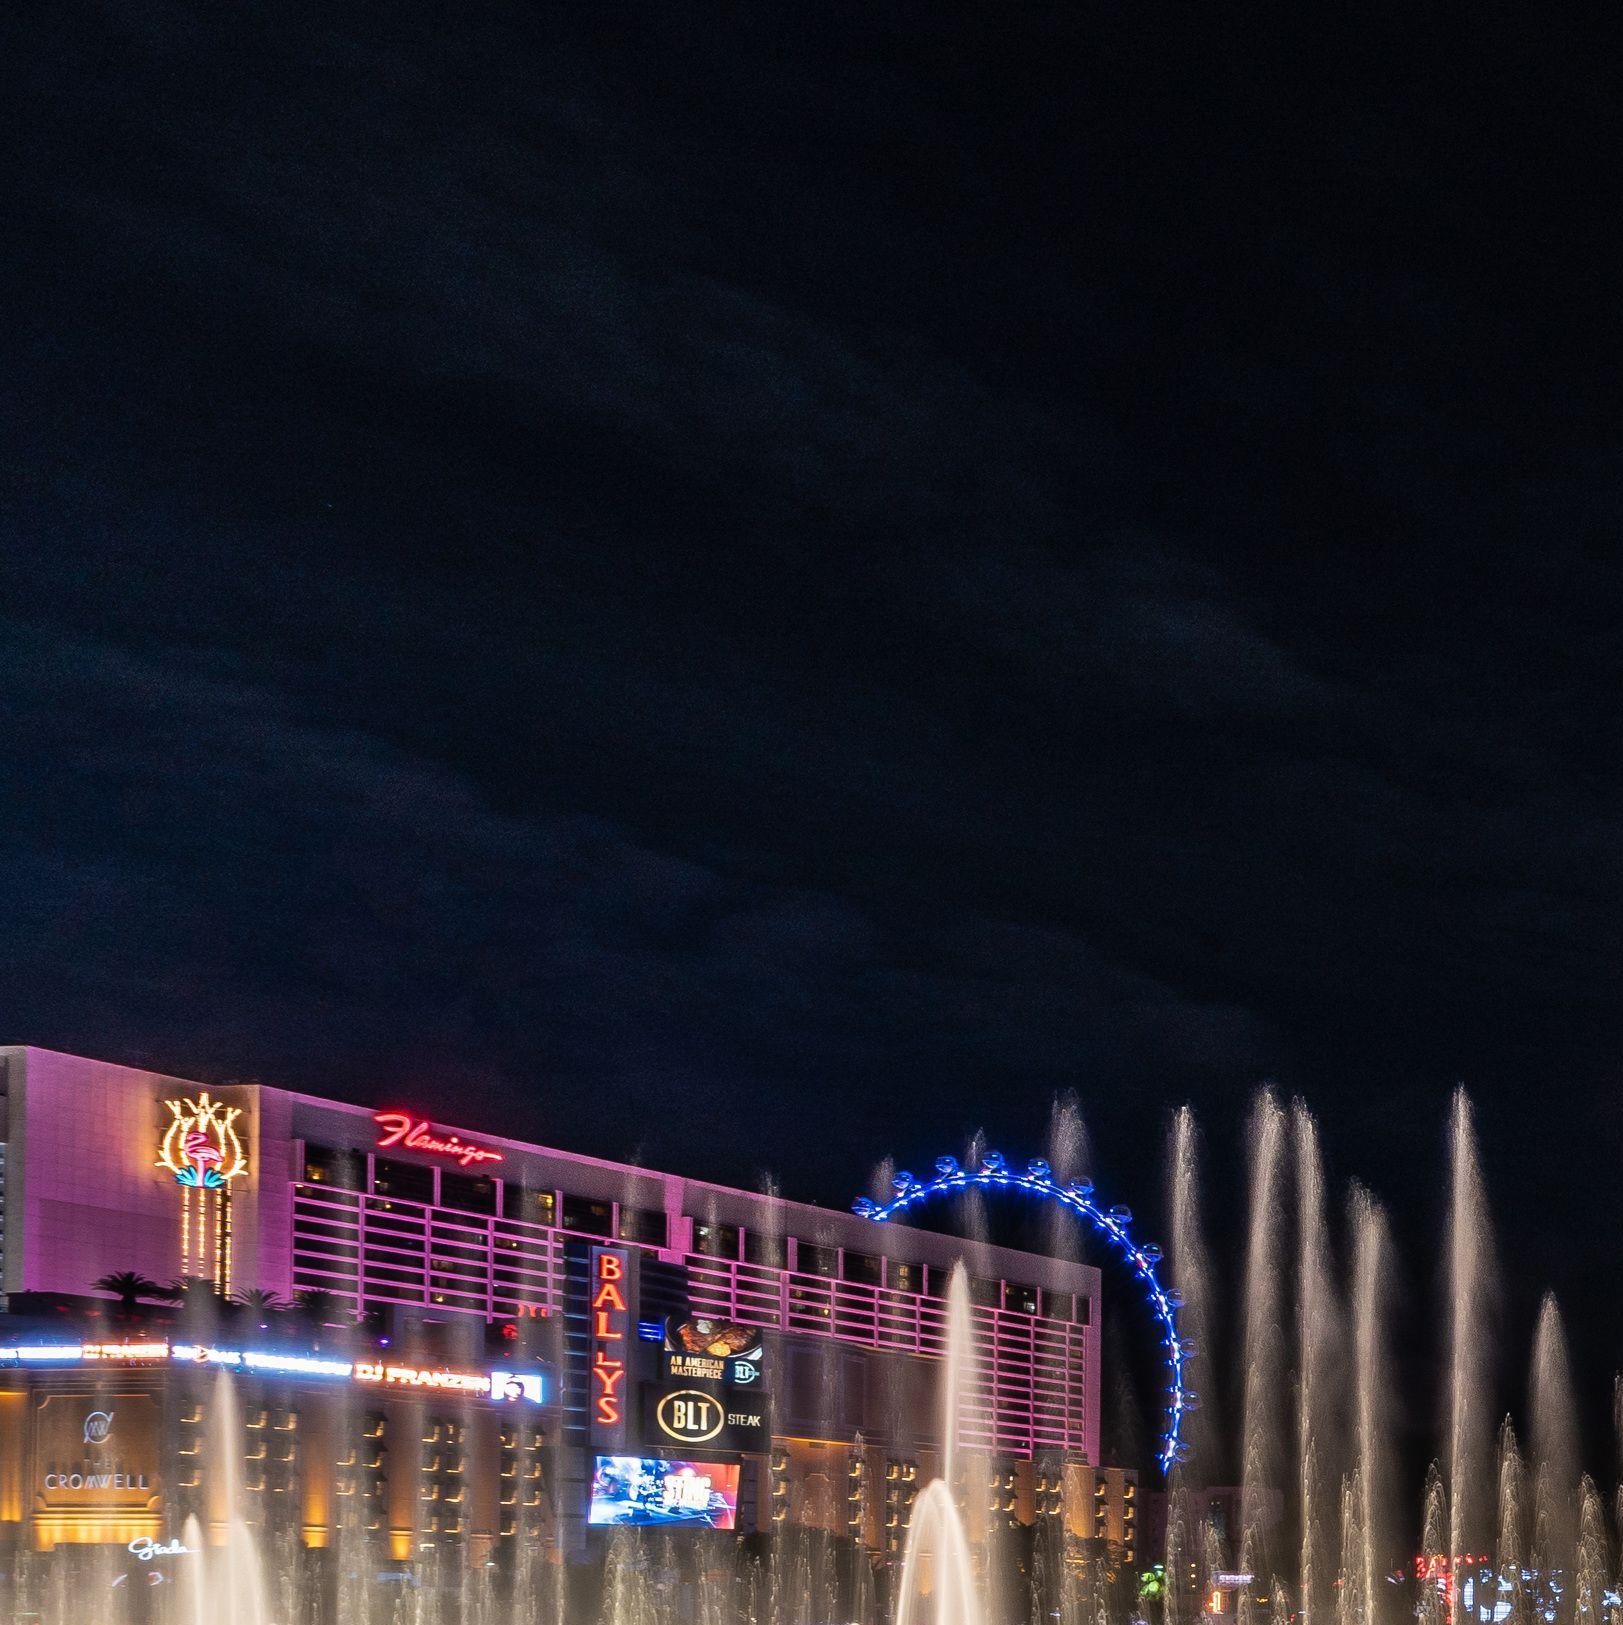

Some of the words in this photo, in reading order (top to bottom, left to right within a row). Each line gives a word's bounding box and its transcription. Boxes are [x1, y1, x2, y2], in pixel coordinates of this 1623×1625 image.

[374, 1114, 502, 1166] Flamingo
[592, 1254, 626, 1423] BALLYS
[685, 1356, 725, 1370] AMERICAN
[355, 1364, 383, 1380] DJ
[670, 1365, 723, 1380] MASTERPIECE
[673, 1400, 711, 1431] BLT
[727, 1413, 761, 1427] STEAK
[45, 1474, 149, 1490] CROMWELL
